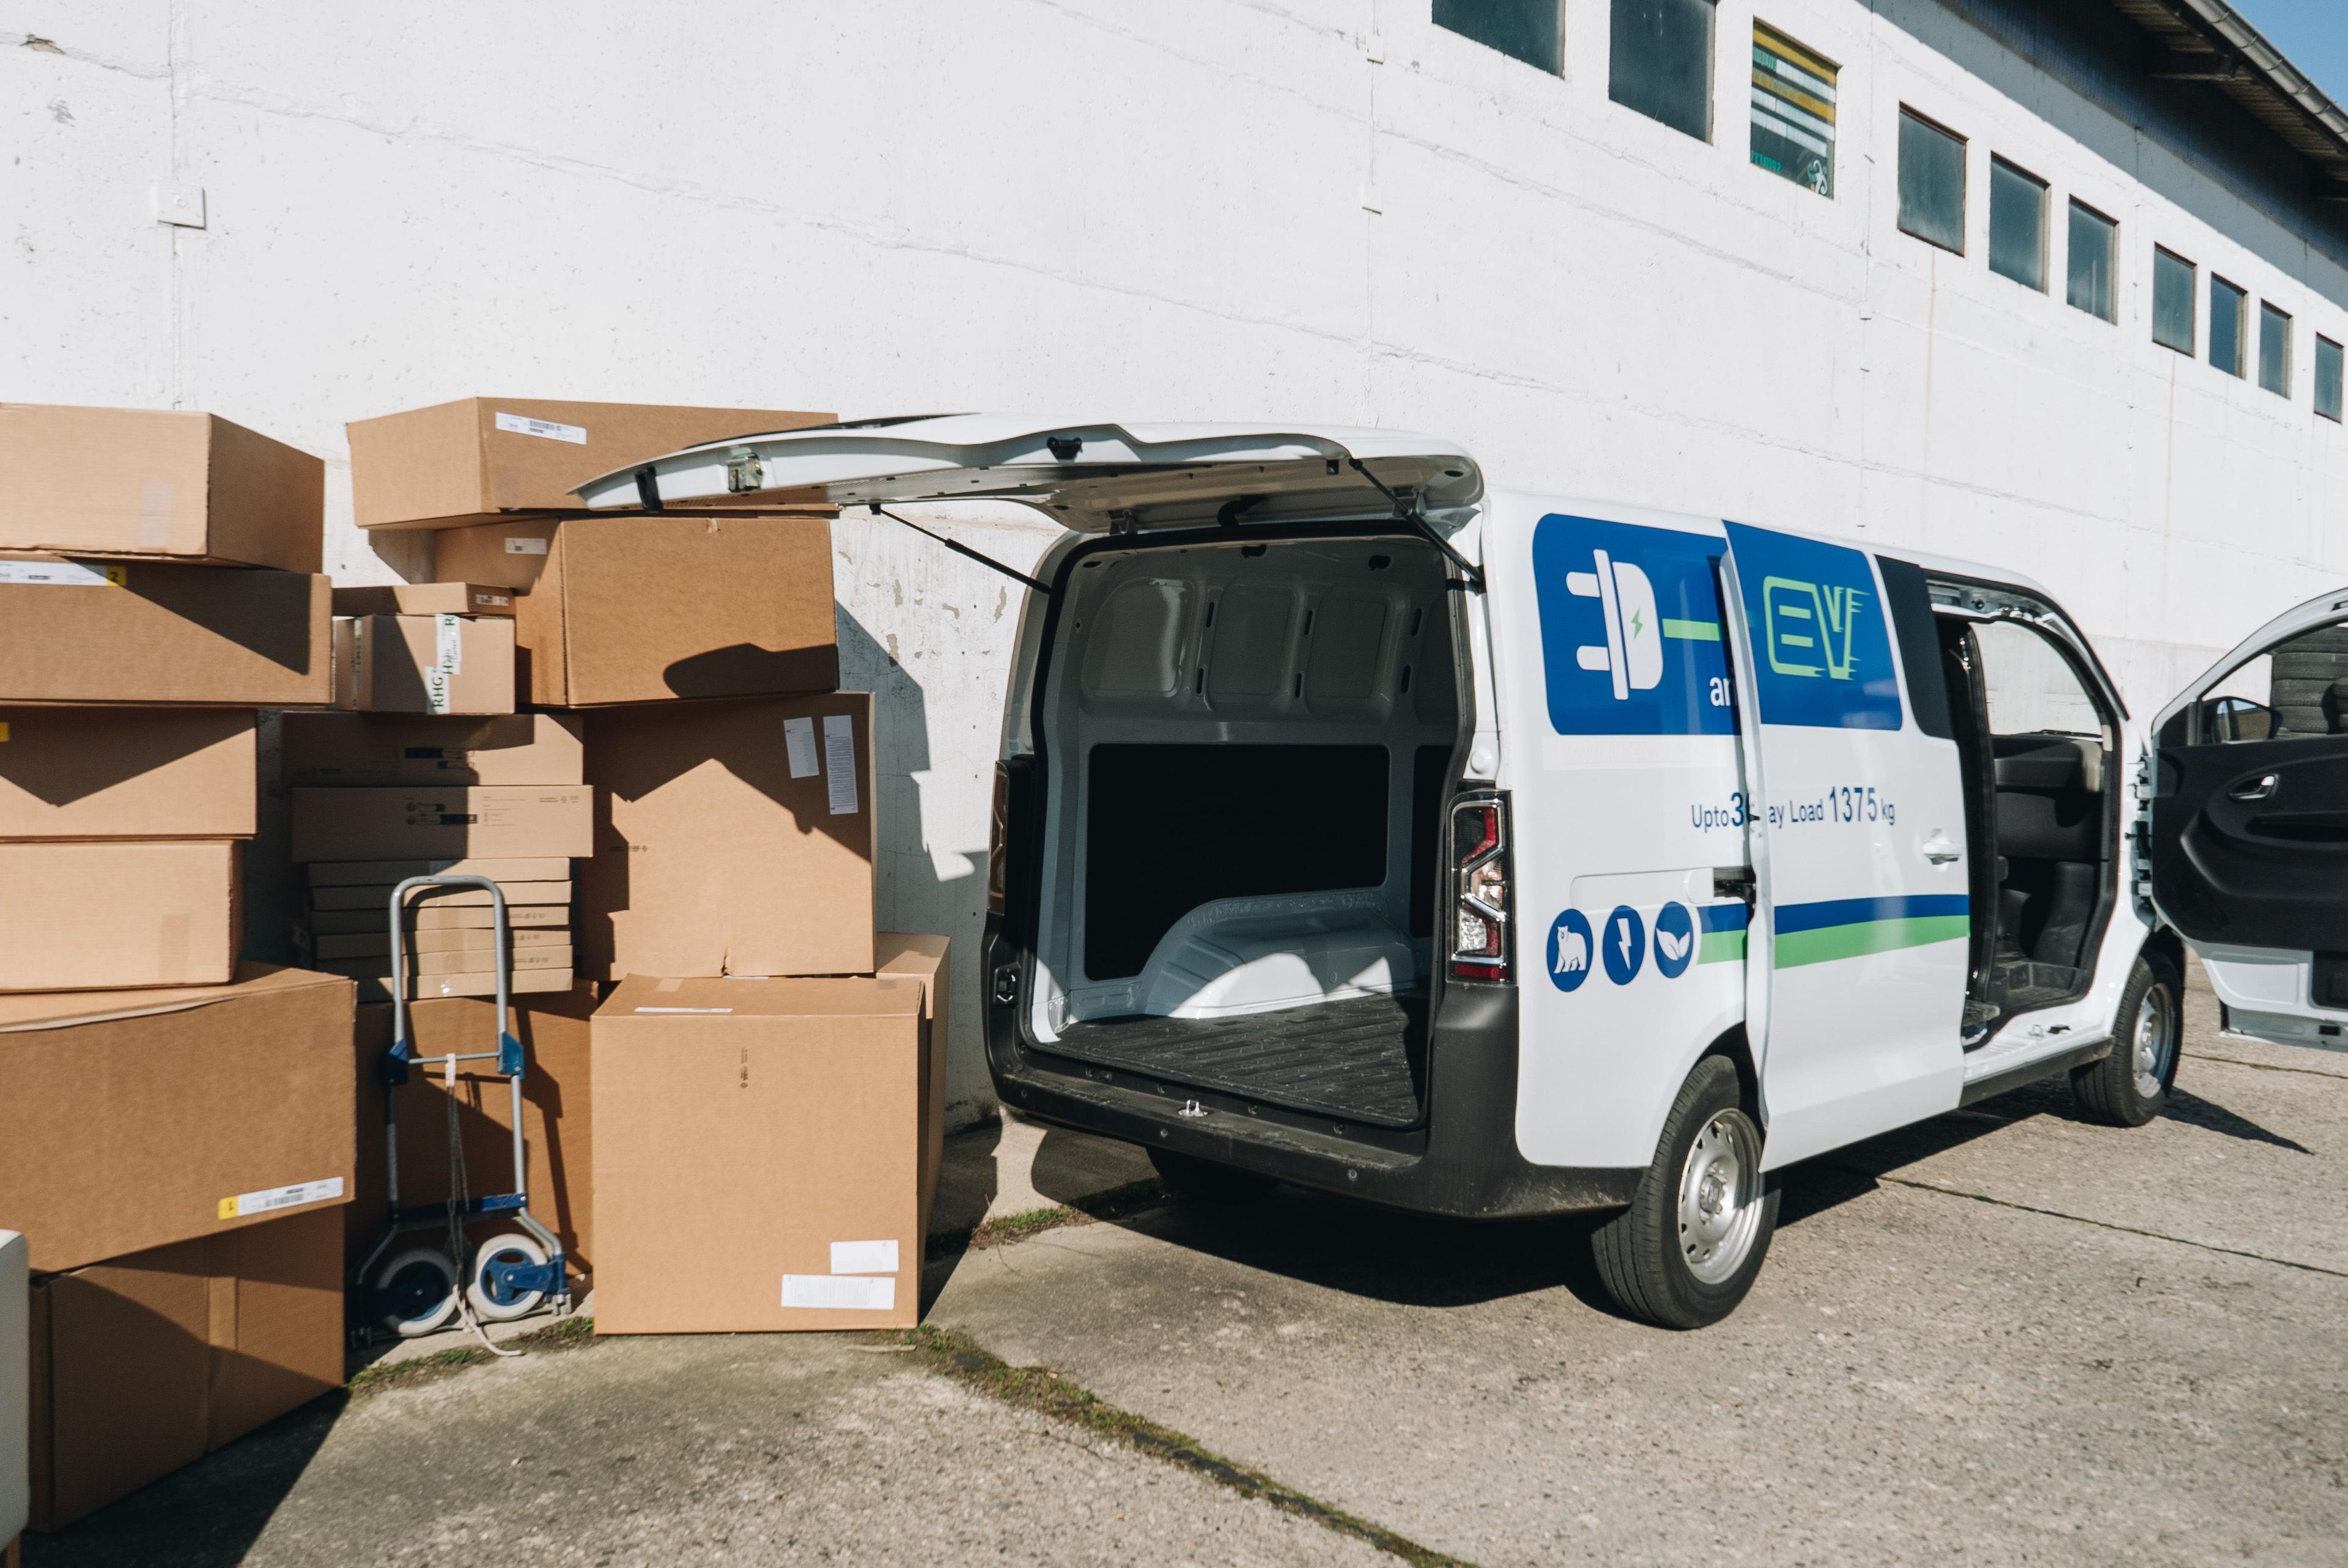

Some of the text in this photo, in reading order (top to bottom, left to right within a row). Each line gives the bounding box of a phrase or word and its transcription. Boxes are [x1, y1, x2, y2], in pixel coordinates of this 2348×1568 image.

[1730, 792, 1749, 826] 3
[1789, 798, 1823, 823] Load
[1829, 786, 1877, 822] 1375
[1880, 798, 1896, 826] kg
